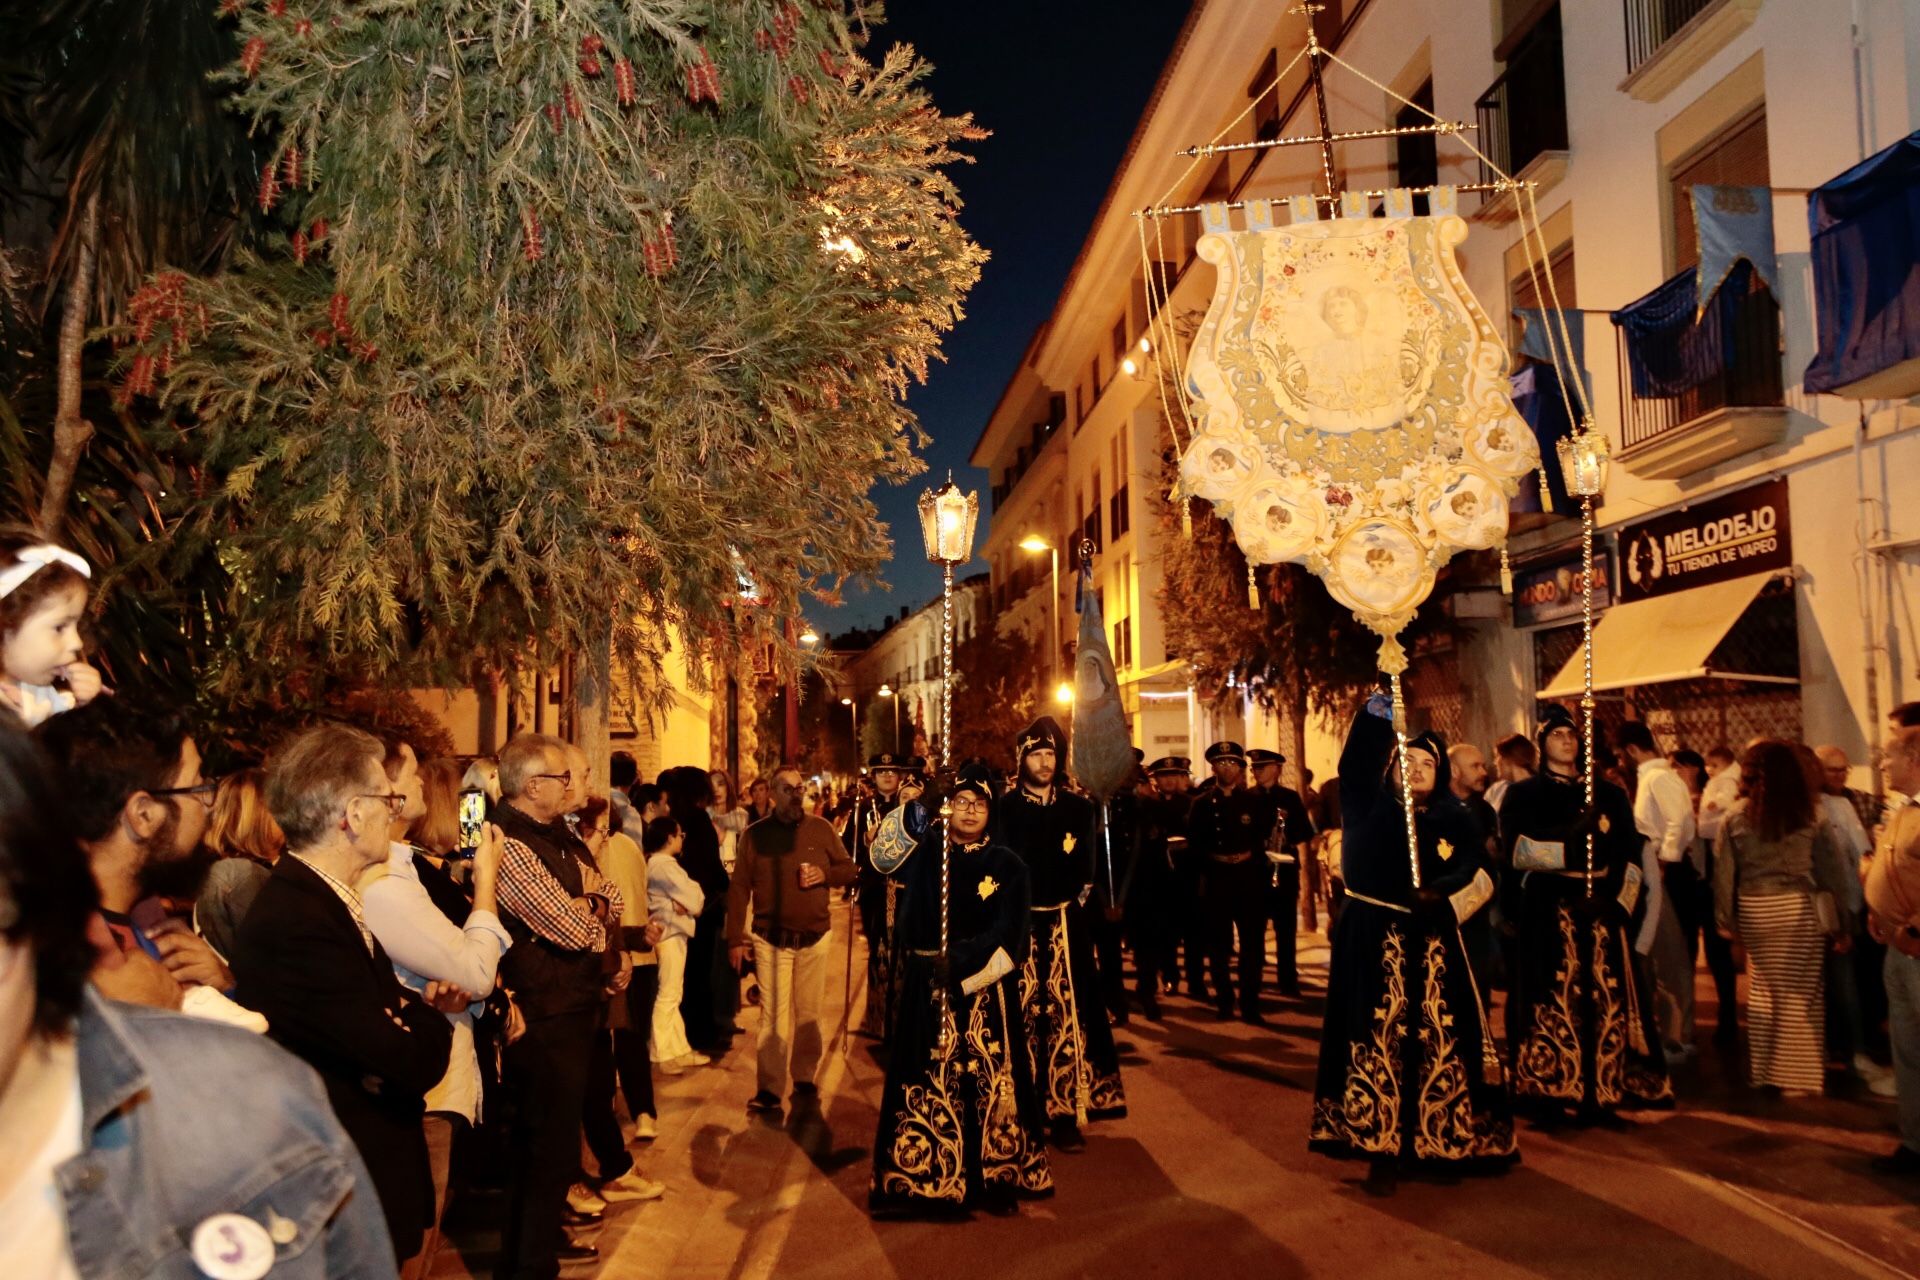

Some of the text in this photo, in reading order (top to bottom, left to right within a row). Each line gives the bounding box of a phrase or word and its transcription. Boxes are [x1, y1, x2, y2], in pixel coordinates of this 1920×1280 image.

[1664, 505, 1776, 557] MELODEJO
[1666, 537, 1777, 576] TU TIENDA DE VAPEO
[1519, 580, 1556, 607] NDO
